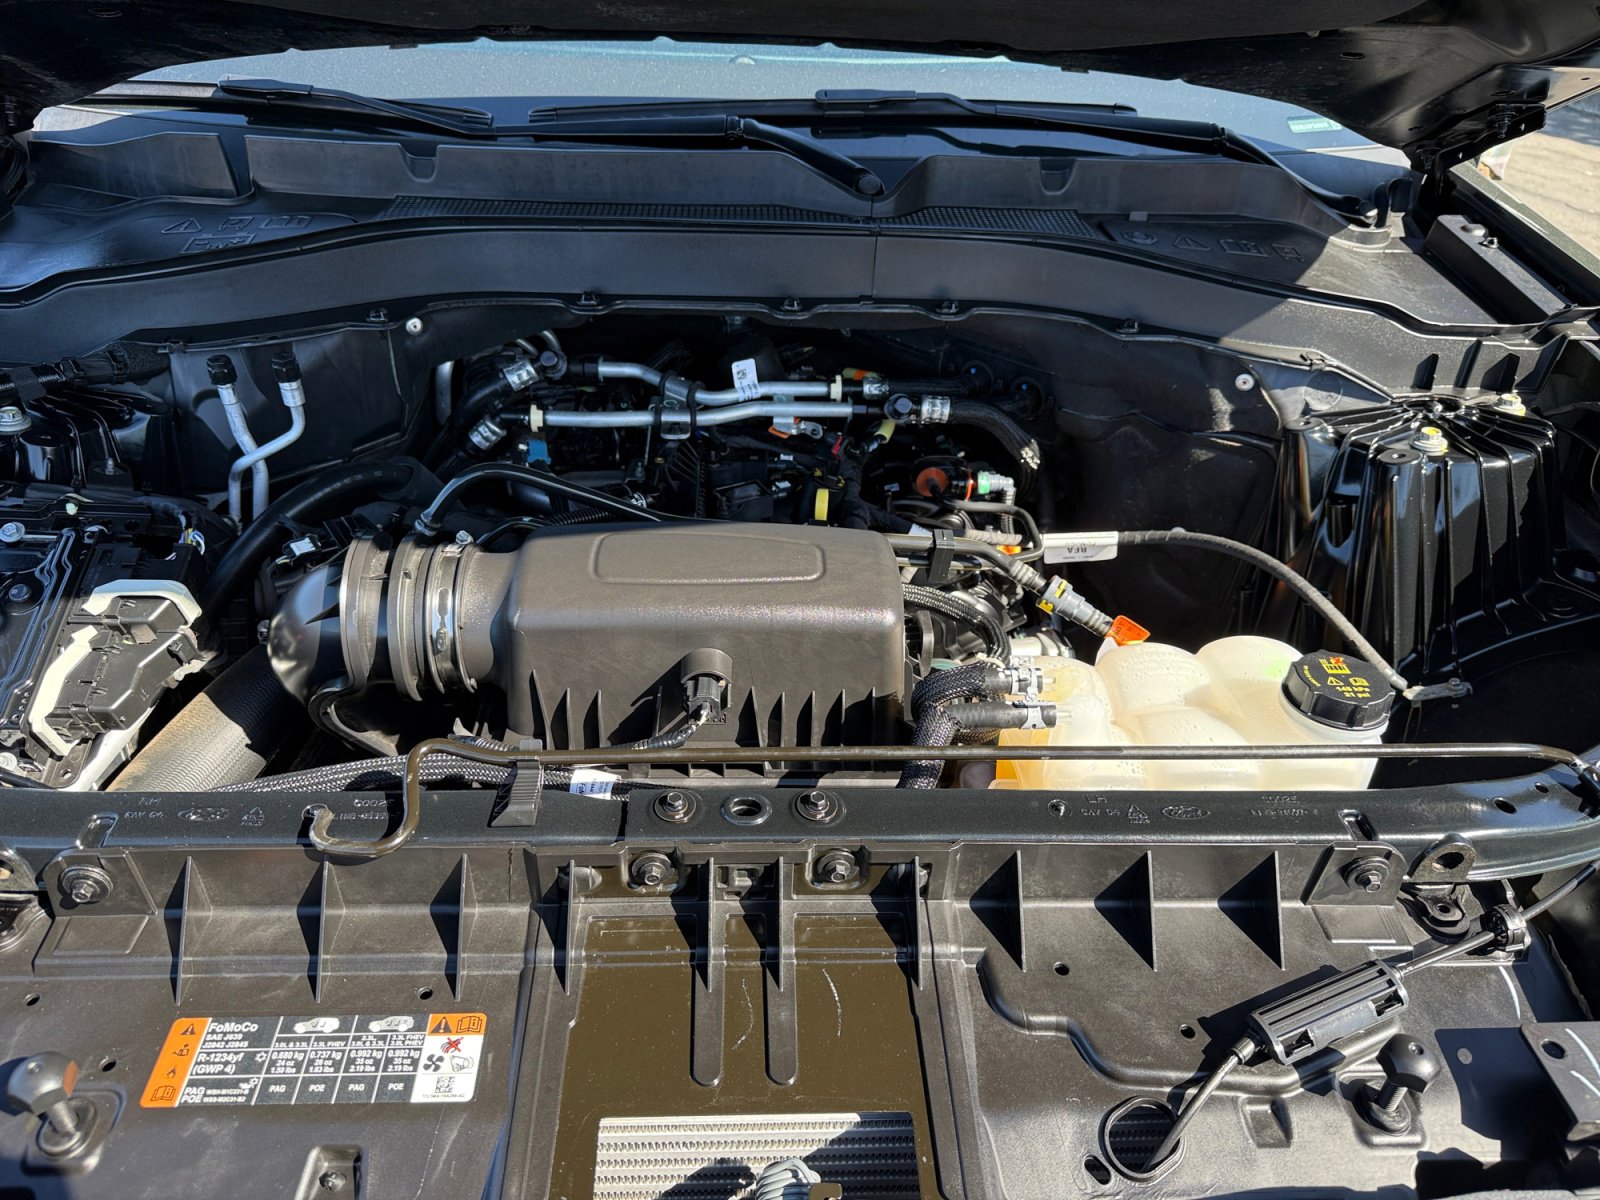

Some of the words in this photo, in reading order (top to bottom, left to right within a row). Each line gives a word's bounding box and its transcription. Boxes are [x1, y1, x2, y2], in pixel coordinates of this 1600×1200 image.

[208, 1022, 258, 1032] FoMoCo
[205, 1033, 223, 1041] SAE
[223, 1033, 243, 1041] J639
[202, 1041, 225, 1049] J2842
[225, 1041, 249, 1049] J2845
[197, 1052, 245, 1063] R-1234yf
[272, 1051, 293, 1059] 0.680
[293, 1051, 304, 1061] kg
[331, 1050, 342, 1060] kg
[372, 1049, 383, 1059] kg
[387, 1049, 409, 1057] 0.992
[409, 1049, 420, 1058] kg
[192, 1063, 224, 1075] (GWP
[223, 1063, 236, 1075] 4)
[184, 1086, 205, 1095] PAG
[269, 1084, 286, 1093] PAG
[309, 1084, 326, 1092] POE
[348, 1083, 365, 1091] PAG
[387, 1082, 405, 1090] POE
[181, 1094, 204, 1103] POE
